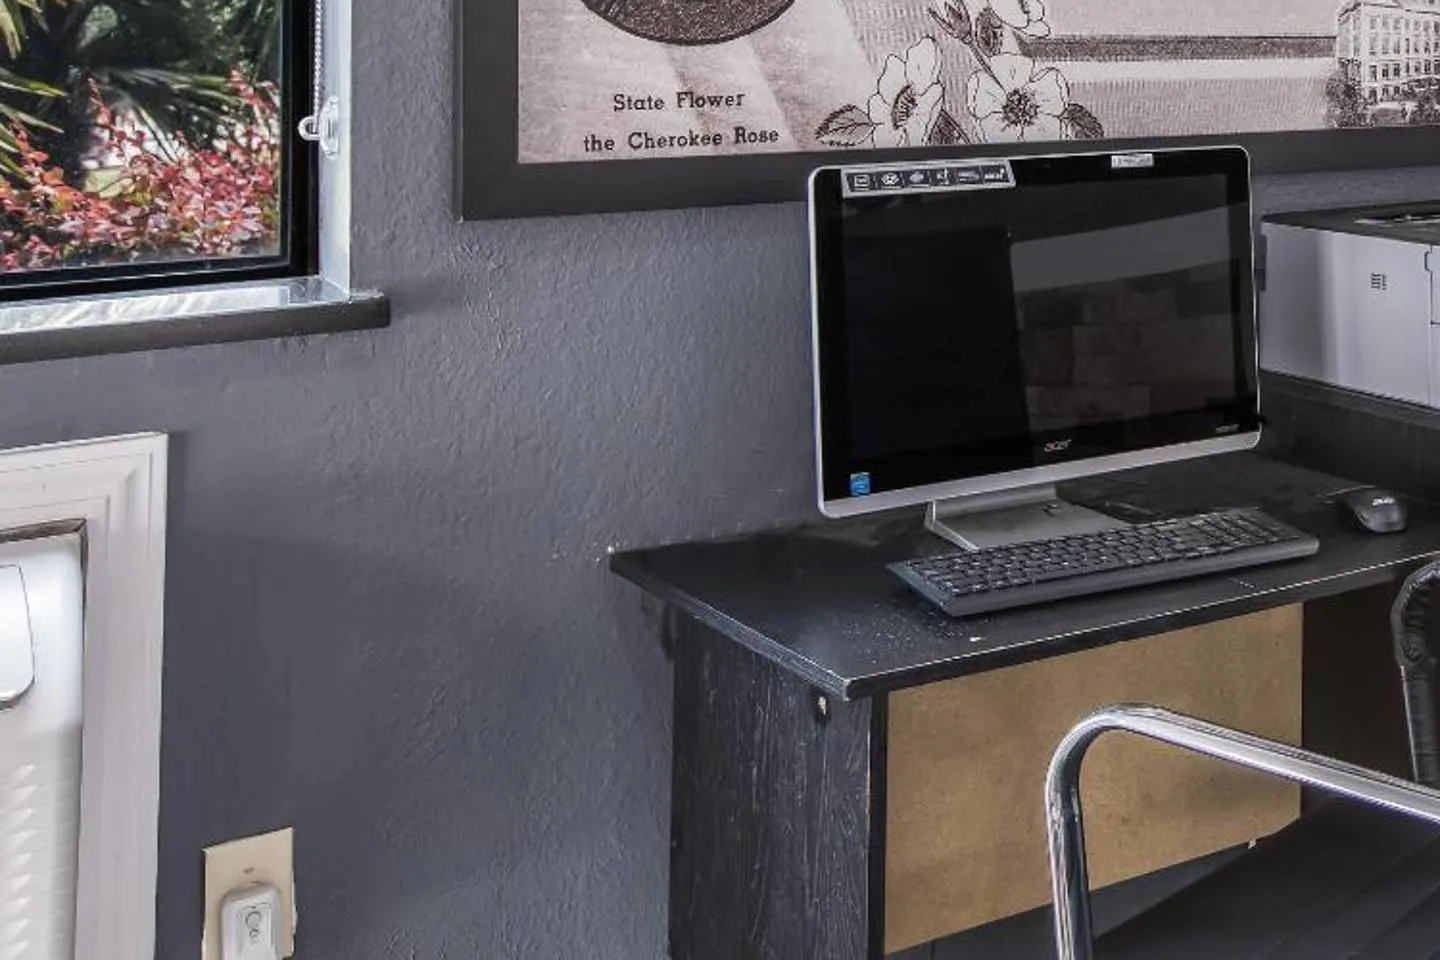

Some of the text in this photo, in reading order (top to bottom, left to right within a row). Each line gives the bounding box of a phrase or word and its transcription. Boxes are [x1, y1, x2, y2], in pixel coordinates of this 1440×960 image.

[613, 90, 746, 112] State Flower
[583, 126, 779, 153] the Cherokee Rose
